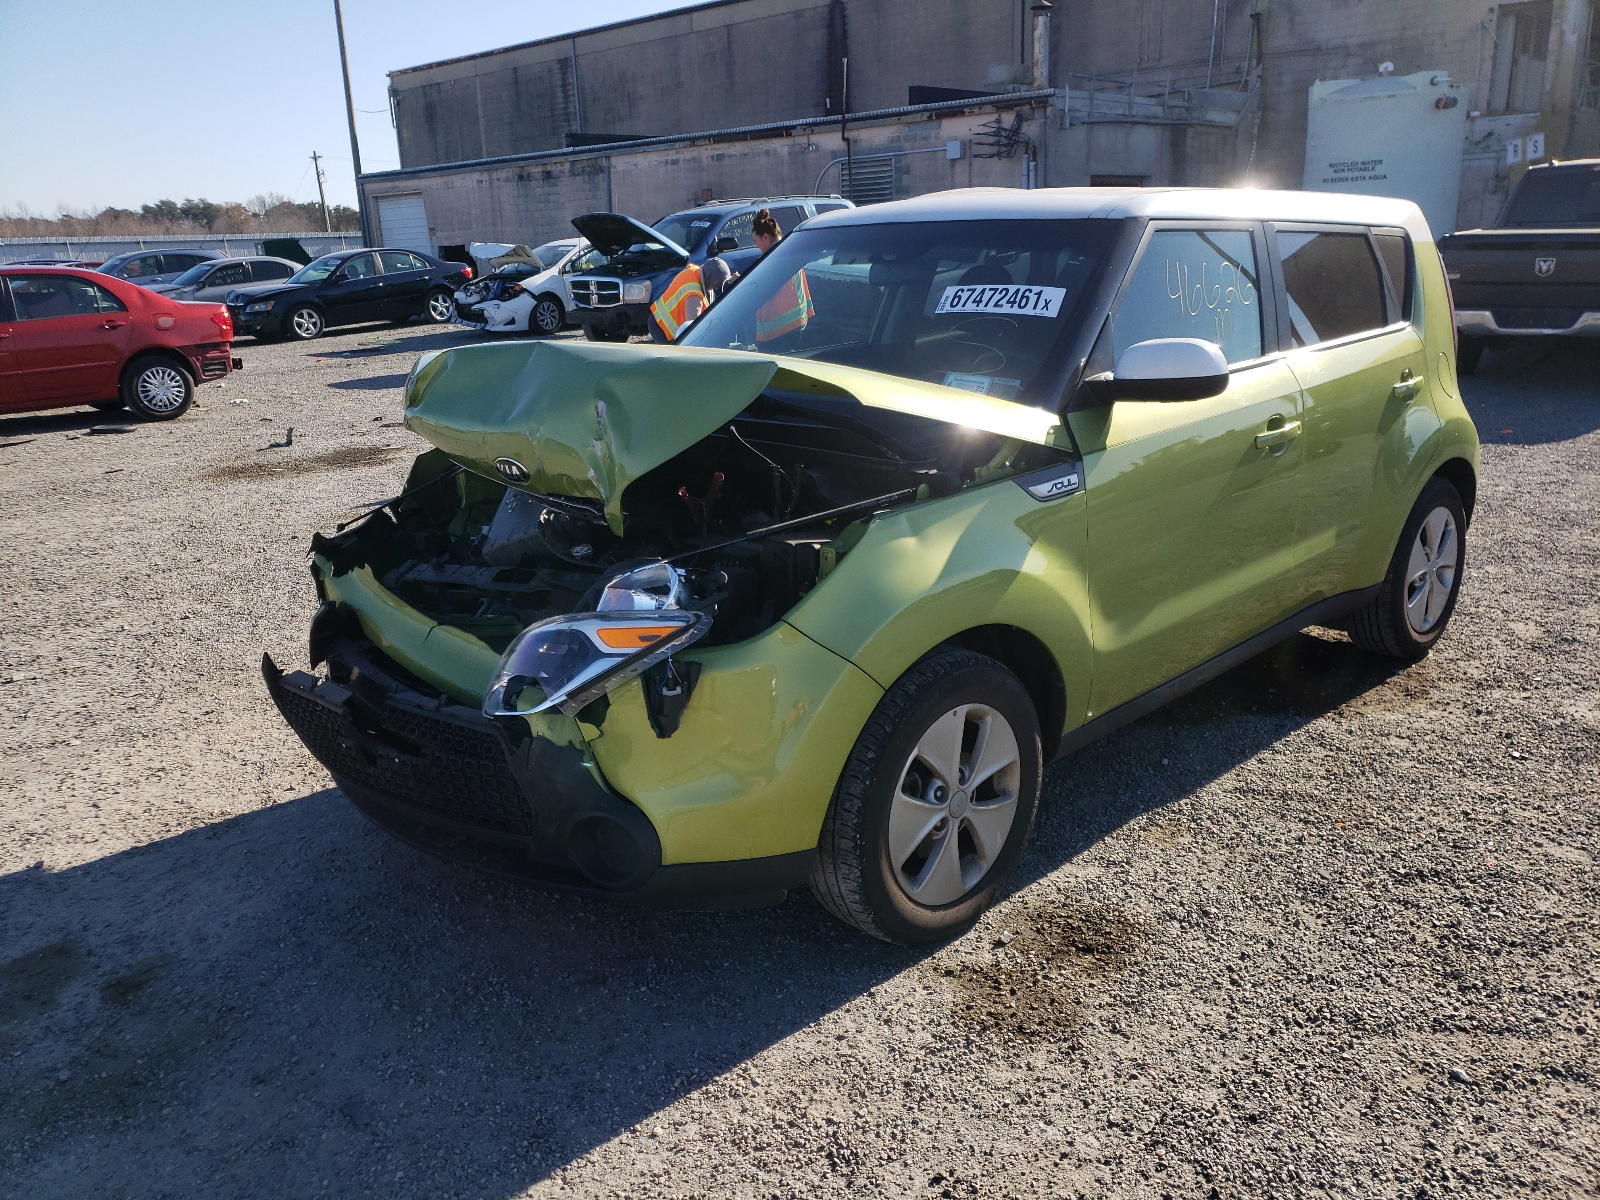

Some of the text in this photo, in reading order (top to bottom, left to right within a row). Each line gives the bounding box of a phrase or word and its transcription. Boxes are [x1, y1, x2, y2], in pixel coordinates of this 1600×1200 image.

[1533, 140, 1539, 154] S
[1360, 159, 1383, 167] WATER
[1347, 165, 1376, 173] POTABLE
[1368, 173, 1387, 181] AGUA
[1165, 258, 1255, 317] 46626
